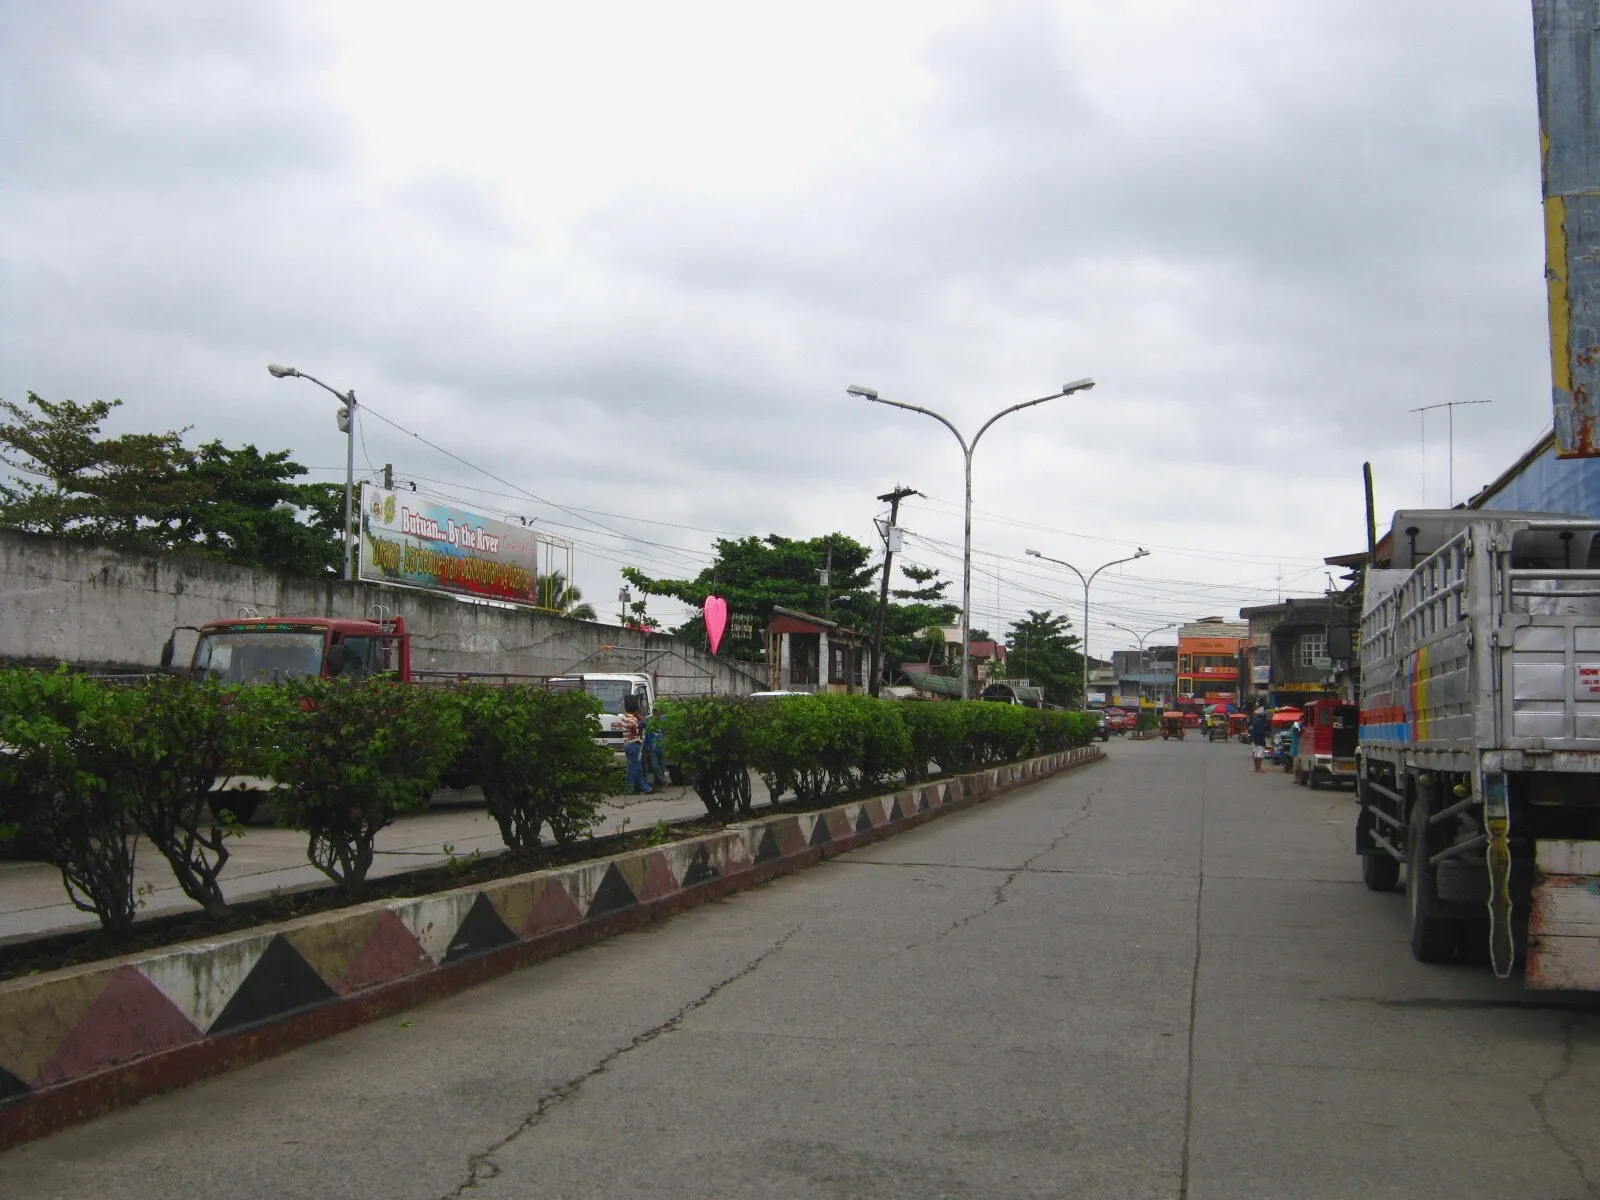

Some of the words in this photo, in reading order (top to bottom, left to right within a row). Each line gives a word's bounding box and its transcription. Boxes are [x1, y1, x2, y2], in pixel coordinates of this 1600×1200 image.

[402, 507, 447, 542] Butuan...
[447, 518, 460, 549] By
[461, 523, 476, 549] the
[476, 526, 499, 553] River
[1580, 668, 1598, 676] HOW
